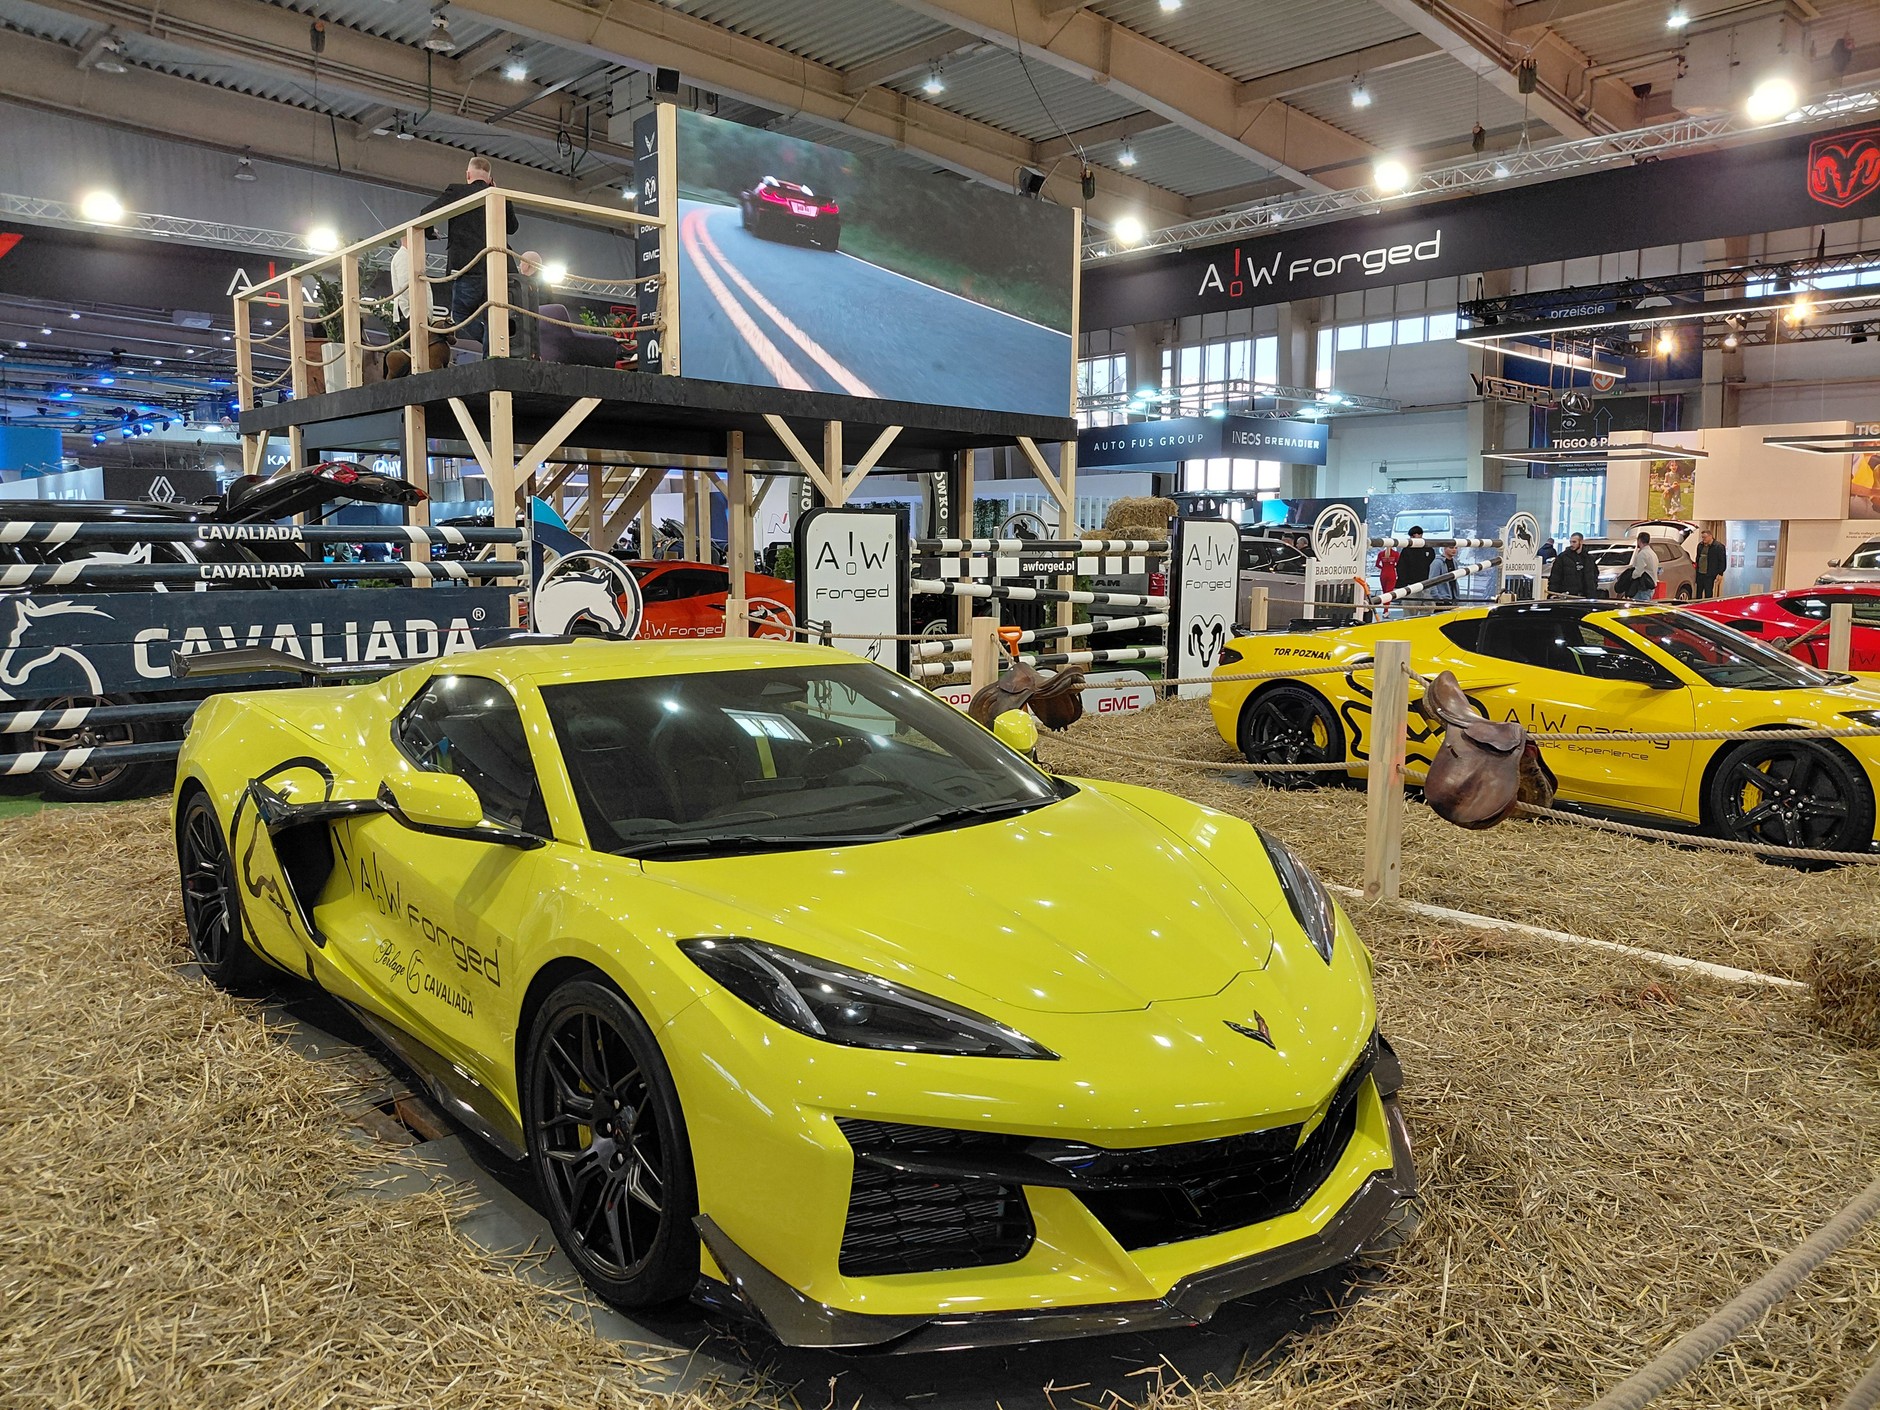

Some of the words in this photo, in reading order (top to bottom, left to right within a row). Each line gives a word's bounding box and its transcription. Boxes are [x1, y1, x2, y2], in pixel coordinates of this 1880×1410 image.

[643, 249, 660, 261] GMC
[1093, 440, 1125, 451] AUTO
[1131, 437, 1154, 449] FUS
[1159, 433, 1204, 446] GROUP
[1232, 430, 1261, 446] INEOS
[1264, 436, 1320, 449] GRENADIER
[1552, 438, 1588, 449] TIGGO
[1590, 437, 1598, 448] 8
[198, 525, 303, 540] CAVALIADA
[200, 564, 305, 579] CAVALIADA
[1022, 560, 1075, 573] awforged.pl
[1273, 648, 1293, 656] TOR
[1098, 695, 1140, 713] GMC
[424, 973, 475, 1020] CAVALIADA
